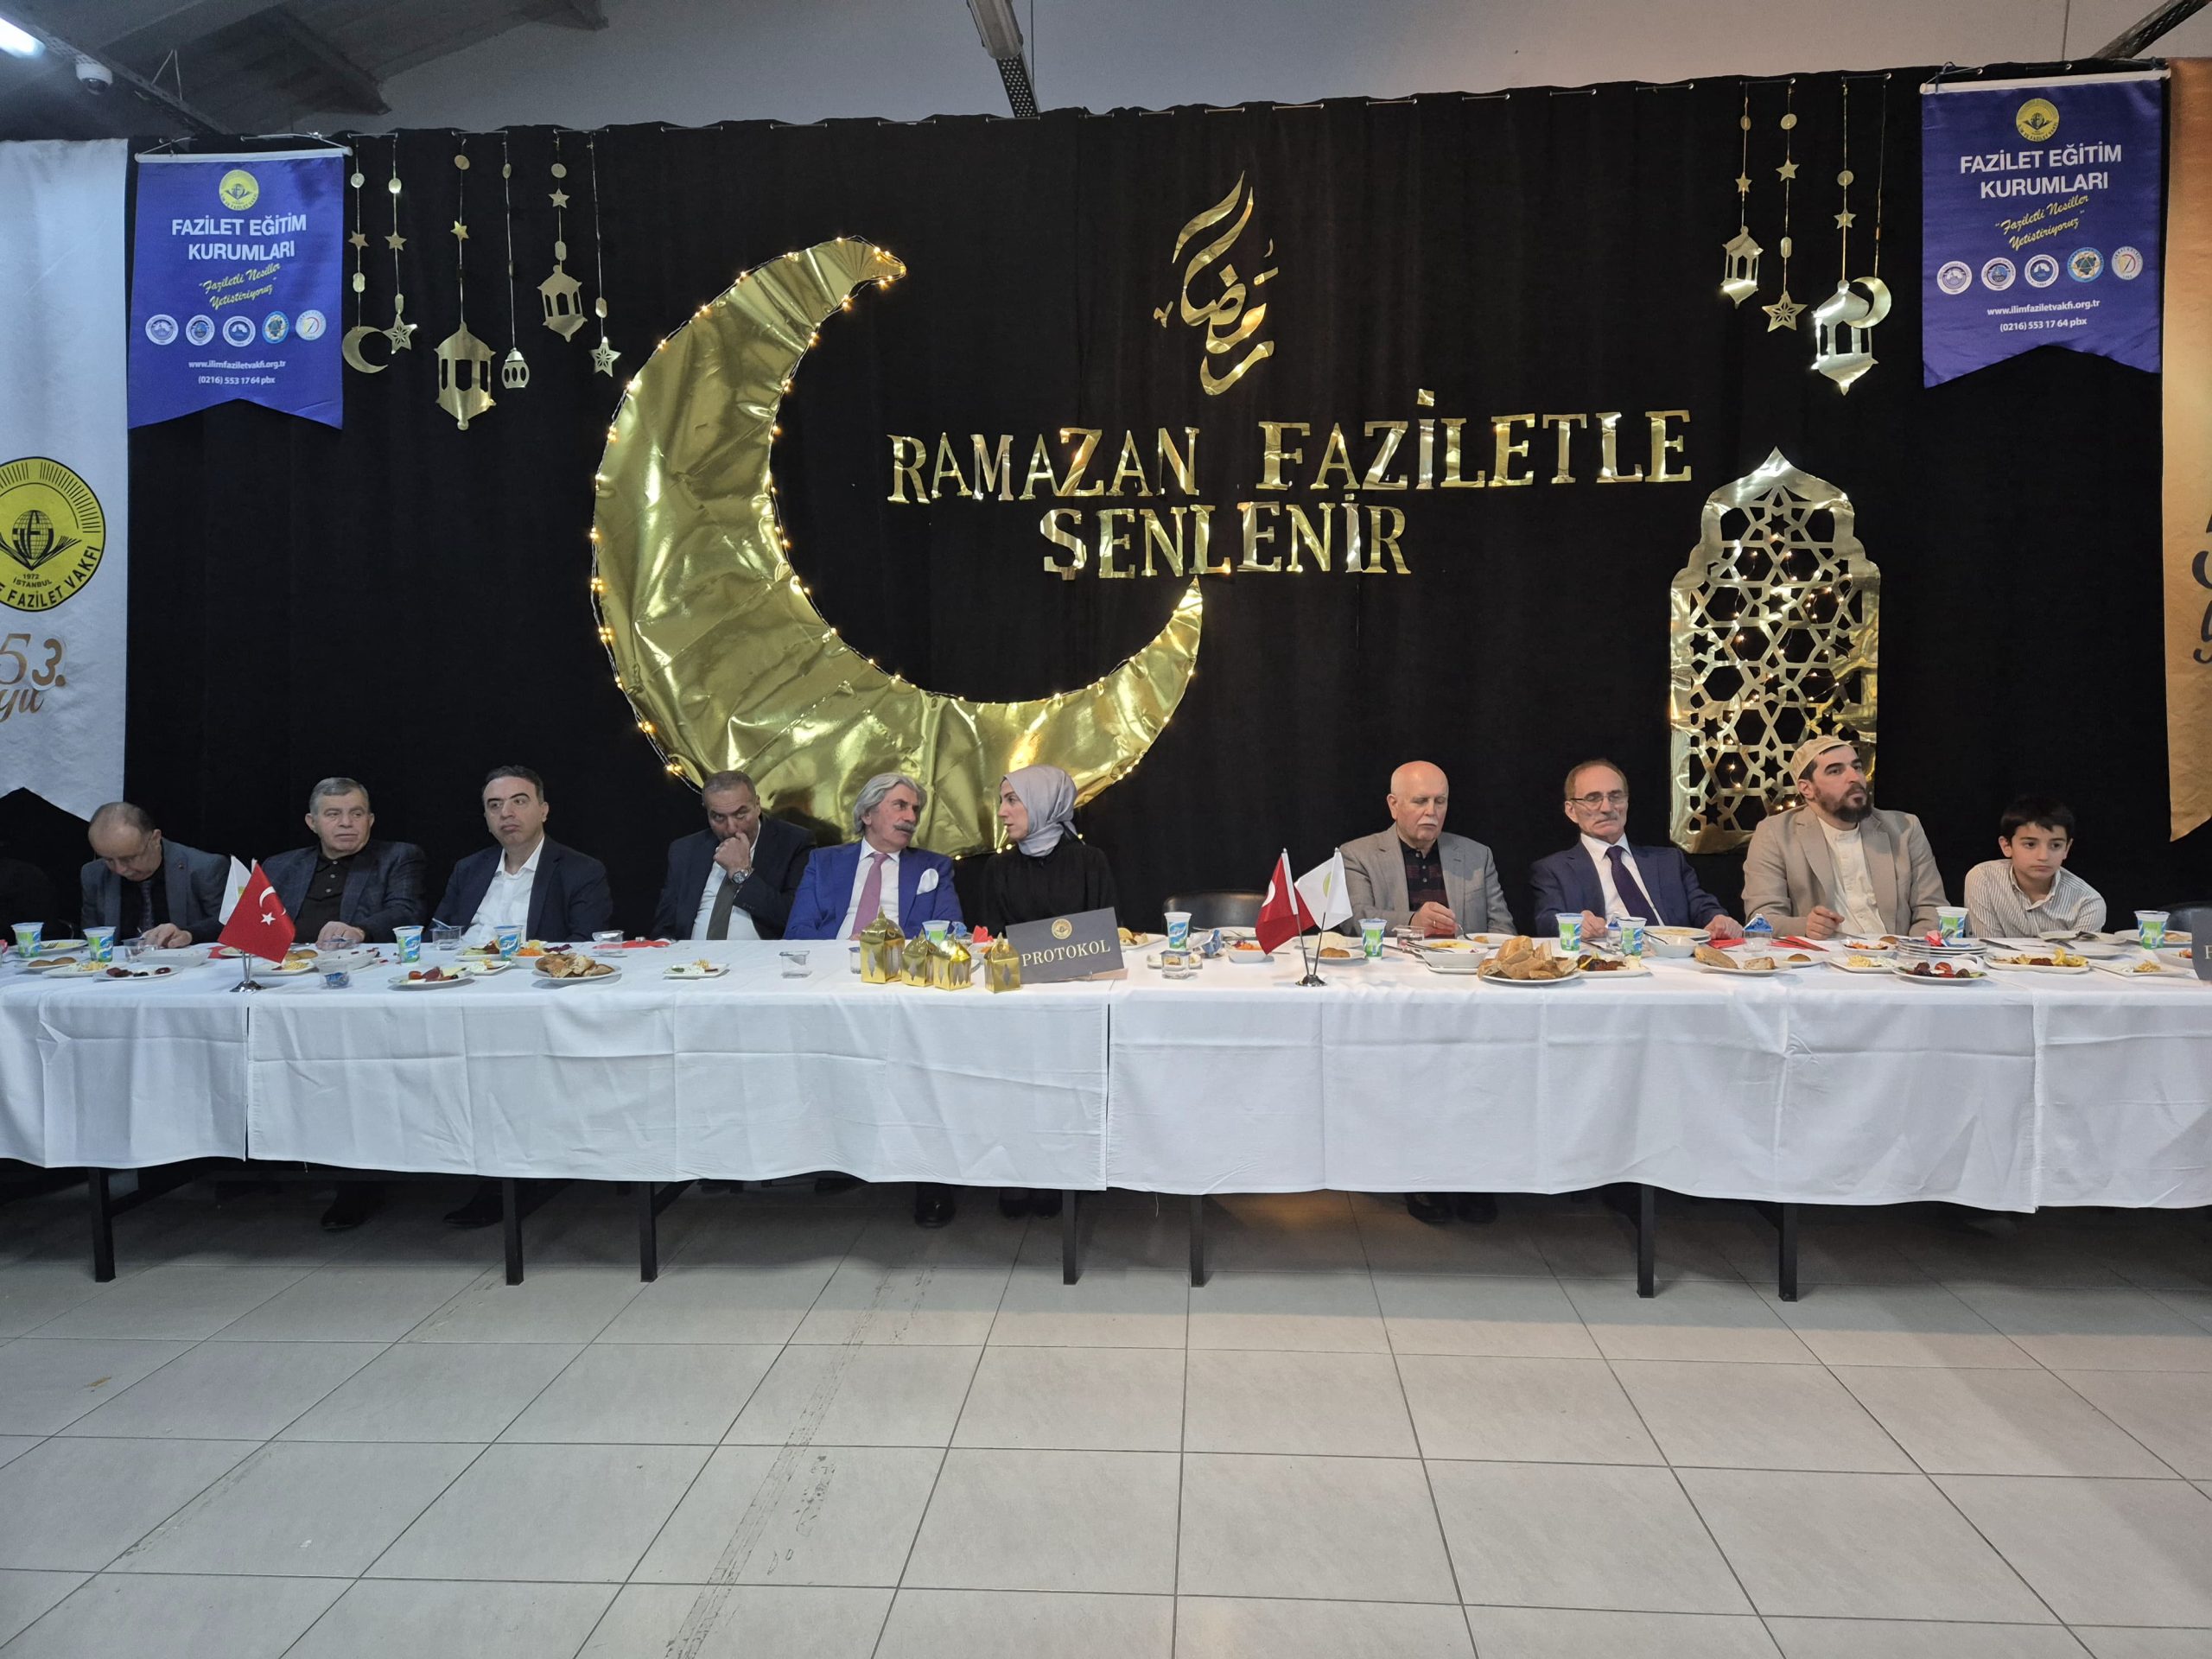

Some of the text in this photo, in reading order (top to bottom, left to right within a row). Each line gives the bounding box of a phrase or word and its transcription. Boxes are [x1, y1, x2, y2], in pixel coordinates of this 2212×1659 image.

[1961, 141, 2122, 174] FAZİLET EĞİTİM
[1980, 171, 2108, 199] KURUMLARI
[2046, 194, 2088, 215] Nesiller
[171, 213, 307, 236] FAZİLET EĞİTİM
[188, 240, 296, 261] KURUMLARI
[245, 263, 281, 281] Nesiller
[1987, 299, 2101, 315] www.ilimfaziletvakfi.org.tr
[1999, 317, 2088, 333] (0216) 553 17 64 pbx
[198, 375, 224, 385] (0216)
[261, 375, 276, 385] pbx
[887, 388, 1692, 504] RAMAZAN FAZİLETLE
[7, 545, 101, 608] FAZİLET VAKFI
[13, 576, 53, 588] İSTANBUL
[1021, 939, 1111, 967] PROTOKOL
